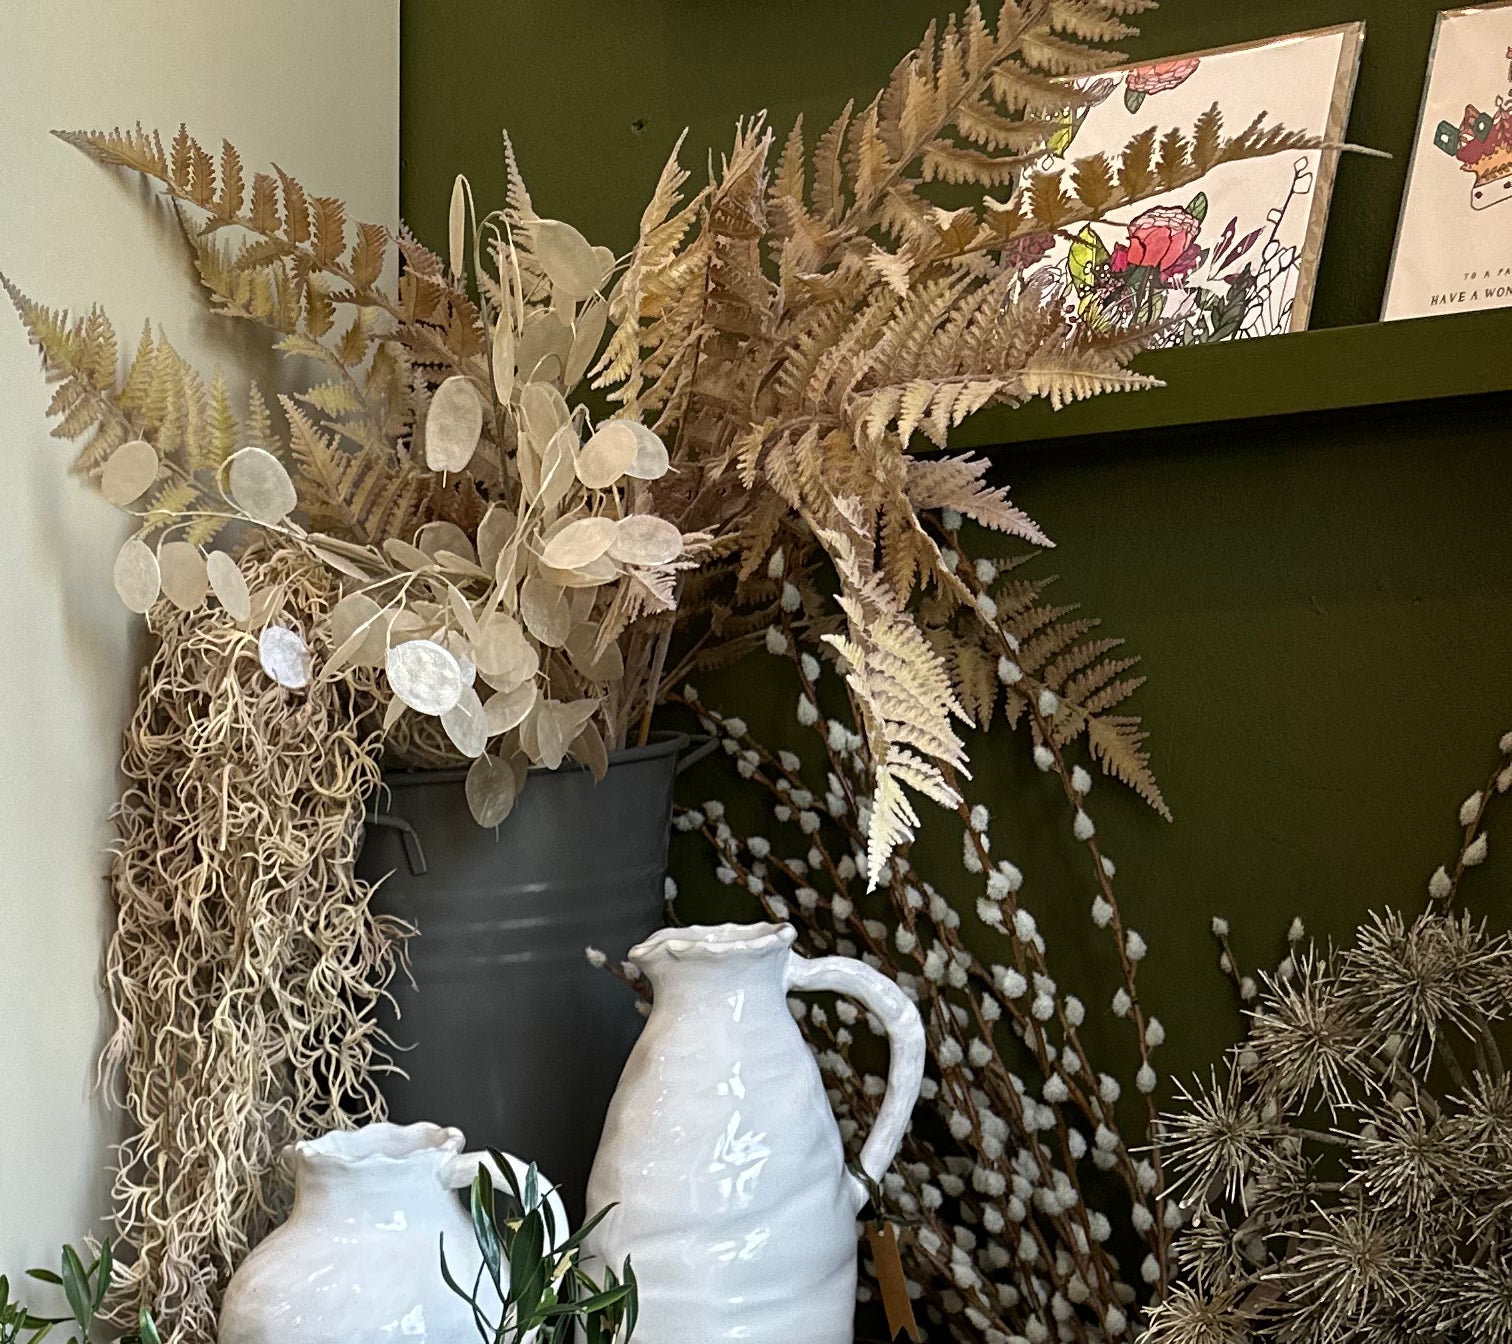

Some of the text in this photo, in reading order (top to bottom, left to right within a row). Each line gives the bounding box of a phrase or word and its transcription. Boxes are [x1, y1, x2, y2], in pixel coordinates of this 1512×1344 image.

[1463, 268, 1511, 281] TO A PA
[1430, 285, 1512, 307] HAVE A WON
